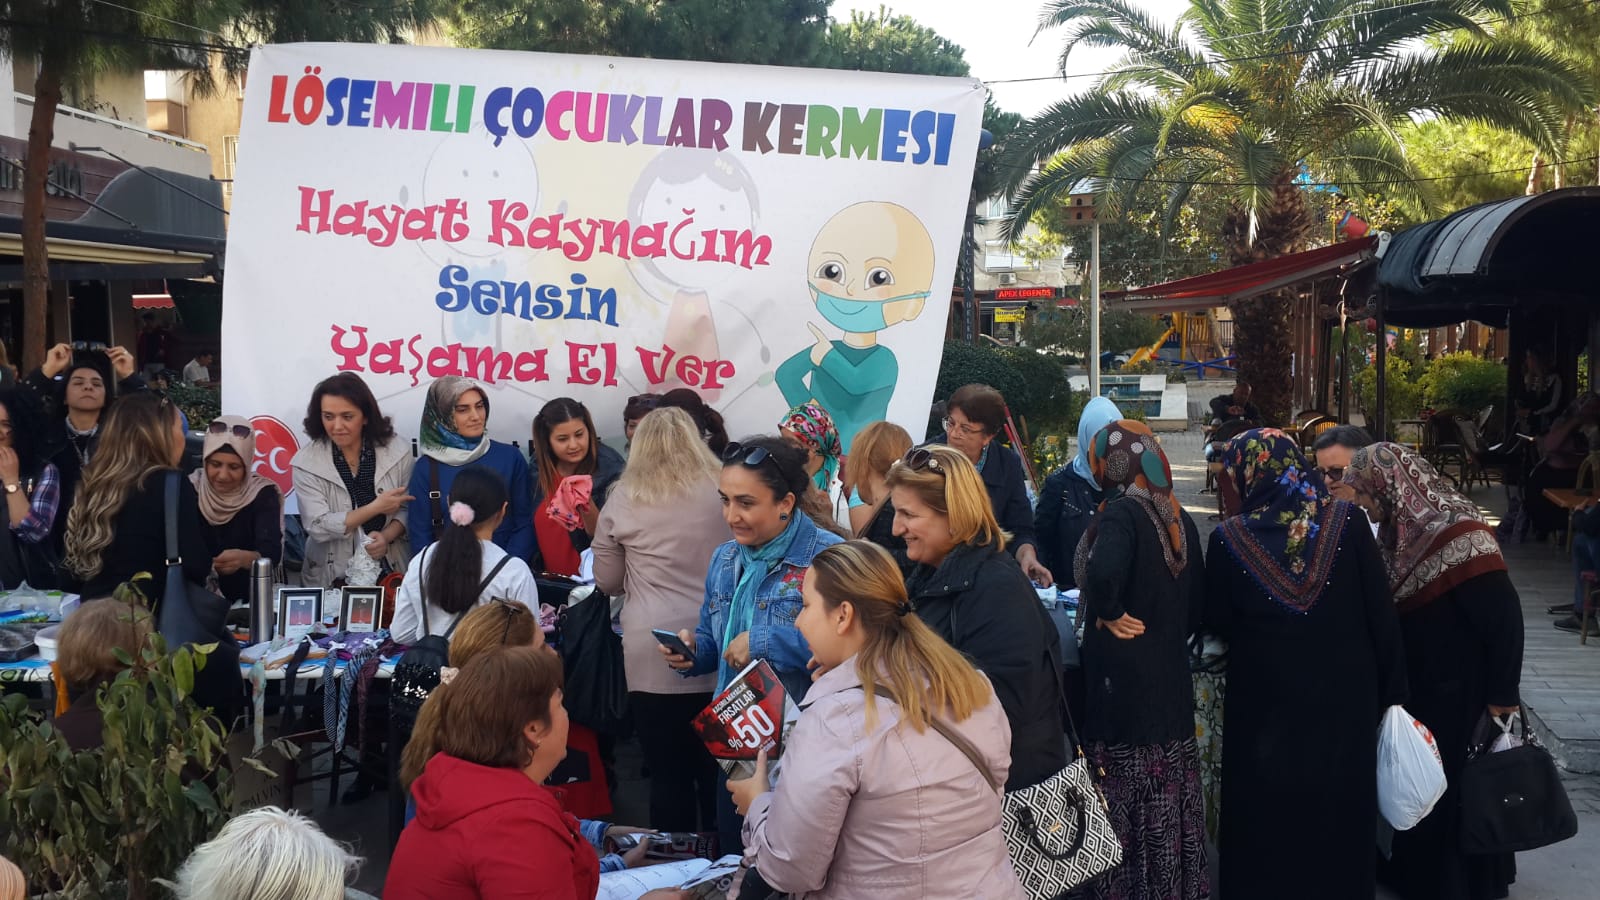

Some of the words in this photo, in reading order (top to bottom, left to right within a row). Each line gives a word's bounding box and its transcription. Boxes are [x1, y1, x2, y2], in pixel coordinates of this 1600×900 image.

[483, 87, 733, 153] ÇOCUKLAR
[296, 185, 470, 247] Hayat
[435, 264, 620, 327] Sensin
[998, 289, 1018, 298] APEX
[1019, 288, 1052, 298] LEGENDS
[330, 324, 549, 387] Yaşama
[564, 340, 618, 387] El
[635, 344, 736, 390] Ver
[717, 689, 756, 725] FIRSATLAR
